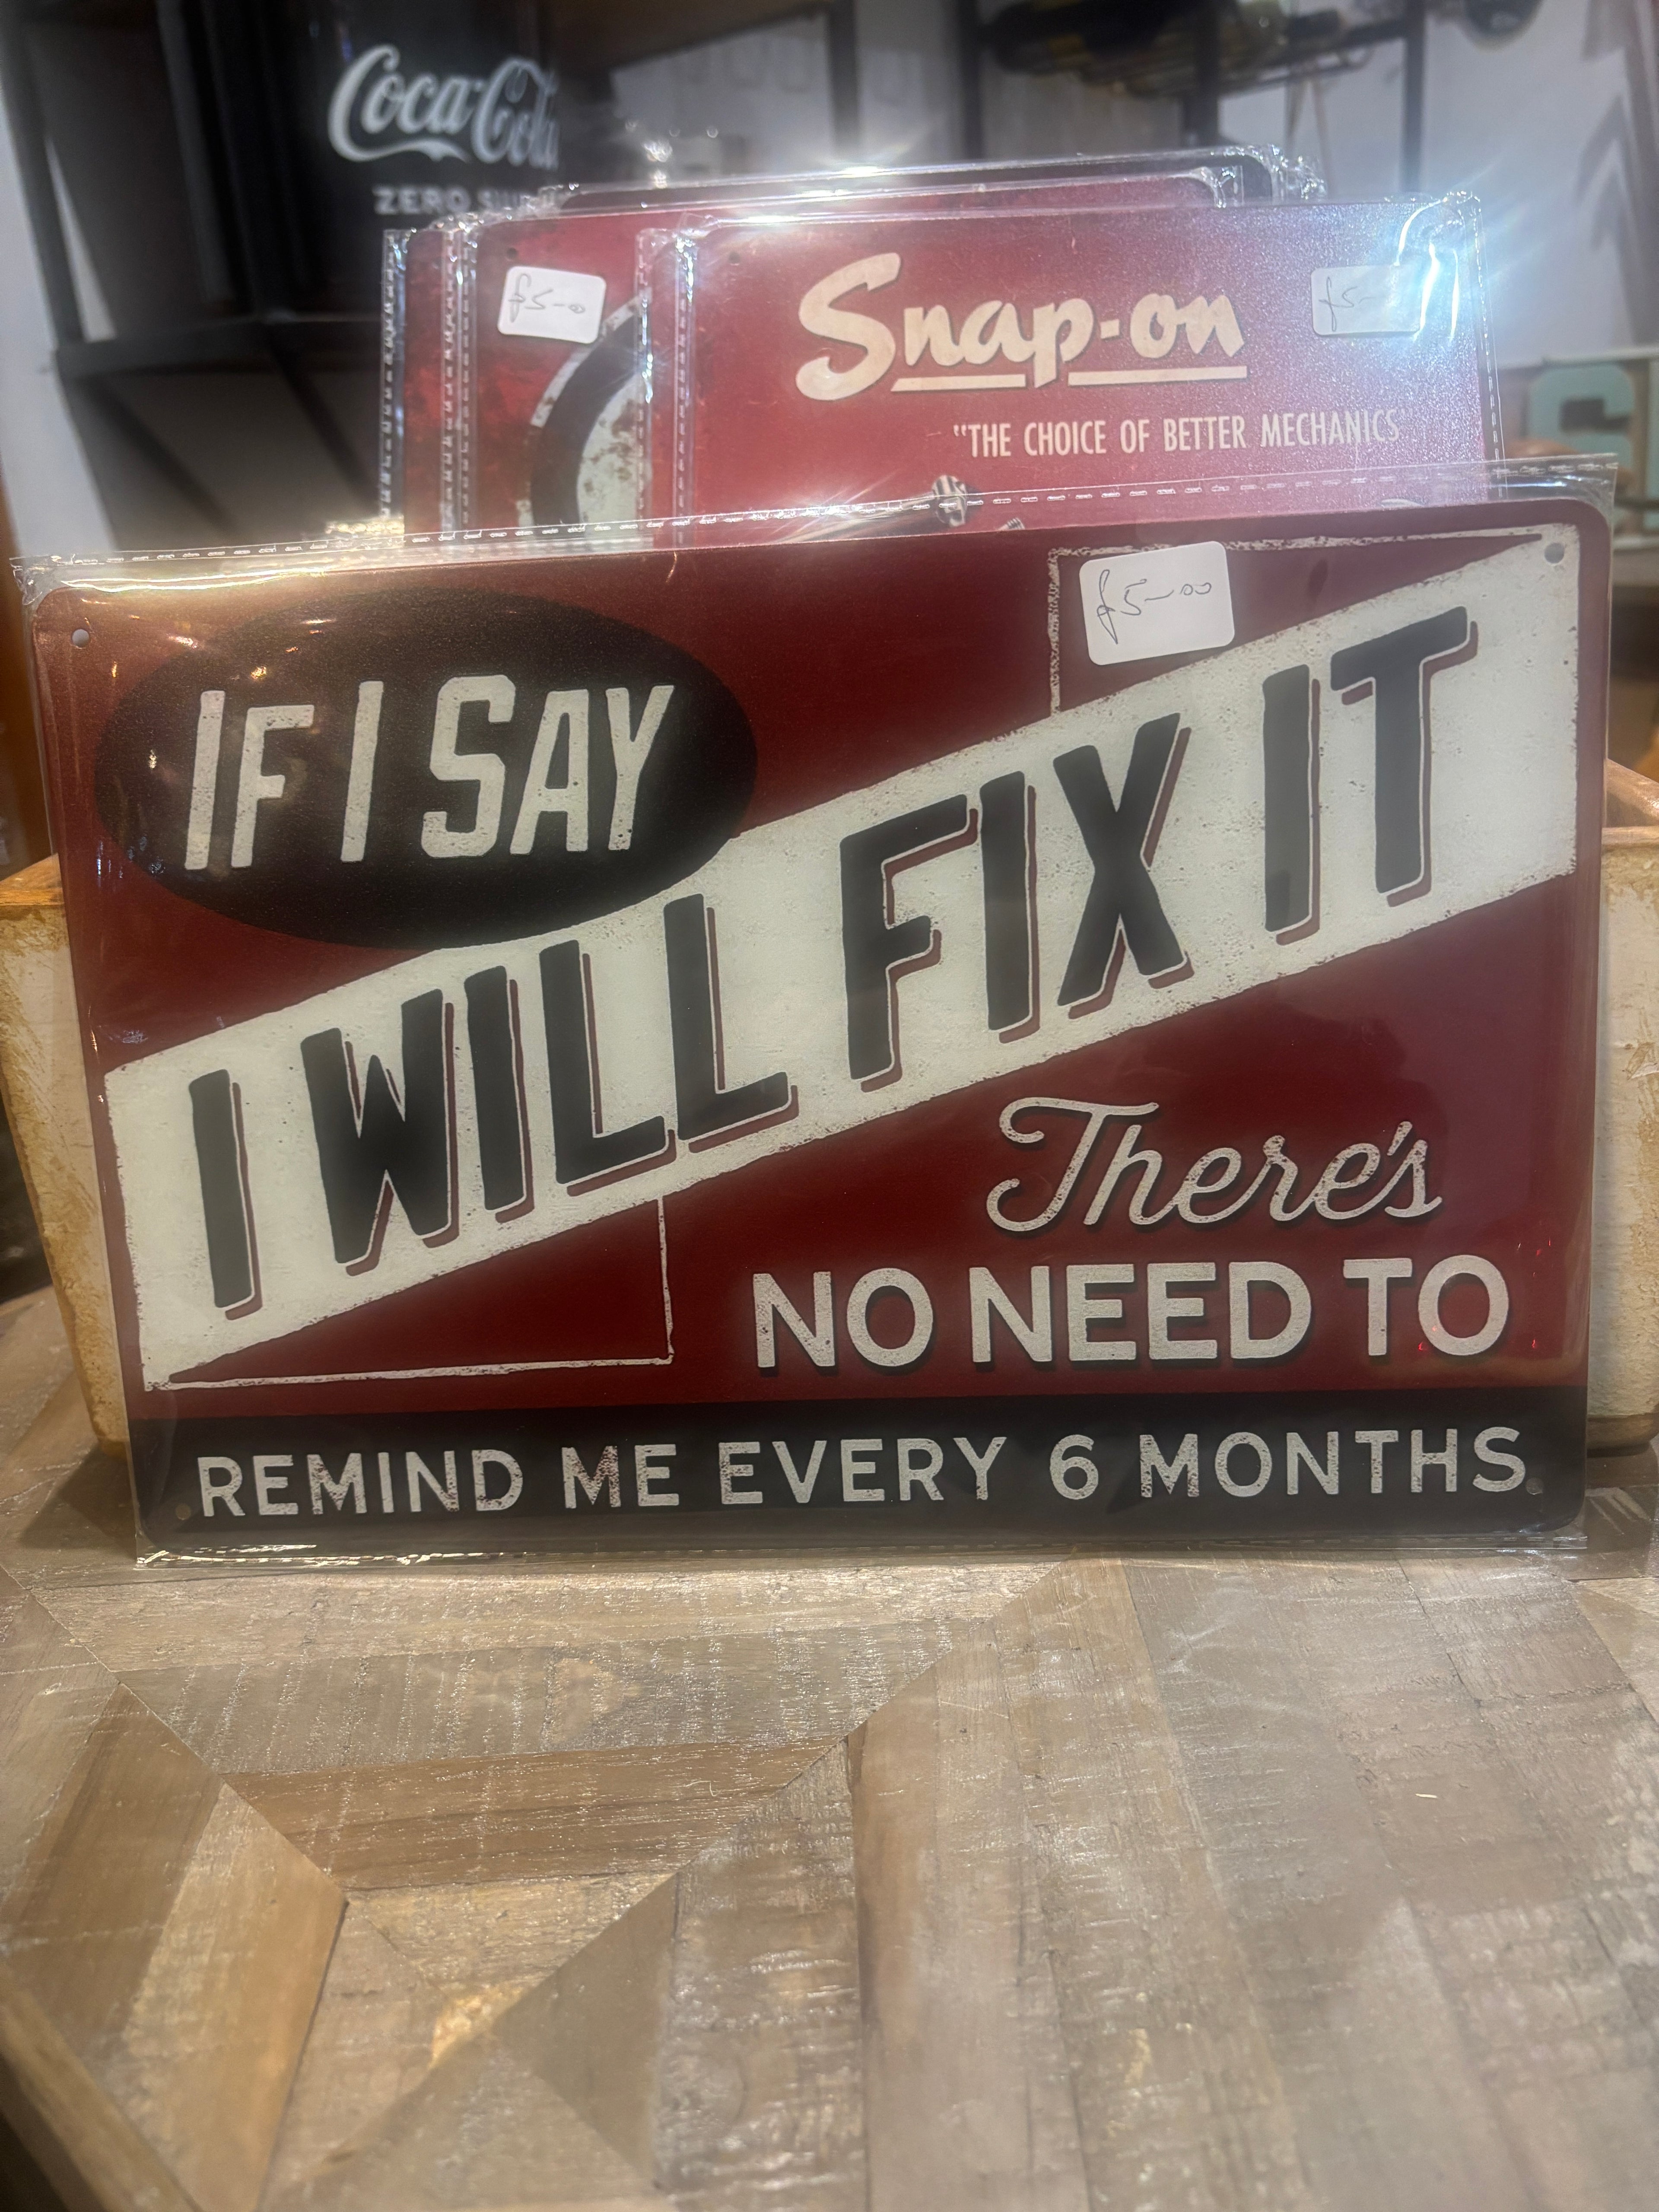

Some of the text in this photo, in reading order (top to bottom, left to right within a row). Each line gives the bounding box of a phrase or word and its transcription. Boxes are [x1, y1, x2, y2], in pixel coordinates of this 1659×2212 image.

[372, 184, 471, 216] ZERO
[796, 252, 1245, 400] Snap-on
[1023, 420, 1106, 456] CHOICE
[1120, 419, 1150, 454] OF
[1163, 415, 1247, 453] BETTER
[185, 674, 674, 870] IF I SAY
[188, 606, 1478, 1320] I WILL FIX IT
[986, 1096, 1443, 1232] There's
[753, 1254, 1510, 1368] NO NEED TO
[197, 1427, 1526, 1517] REMIND ME EVERY 6 MONTHS
